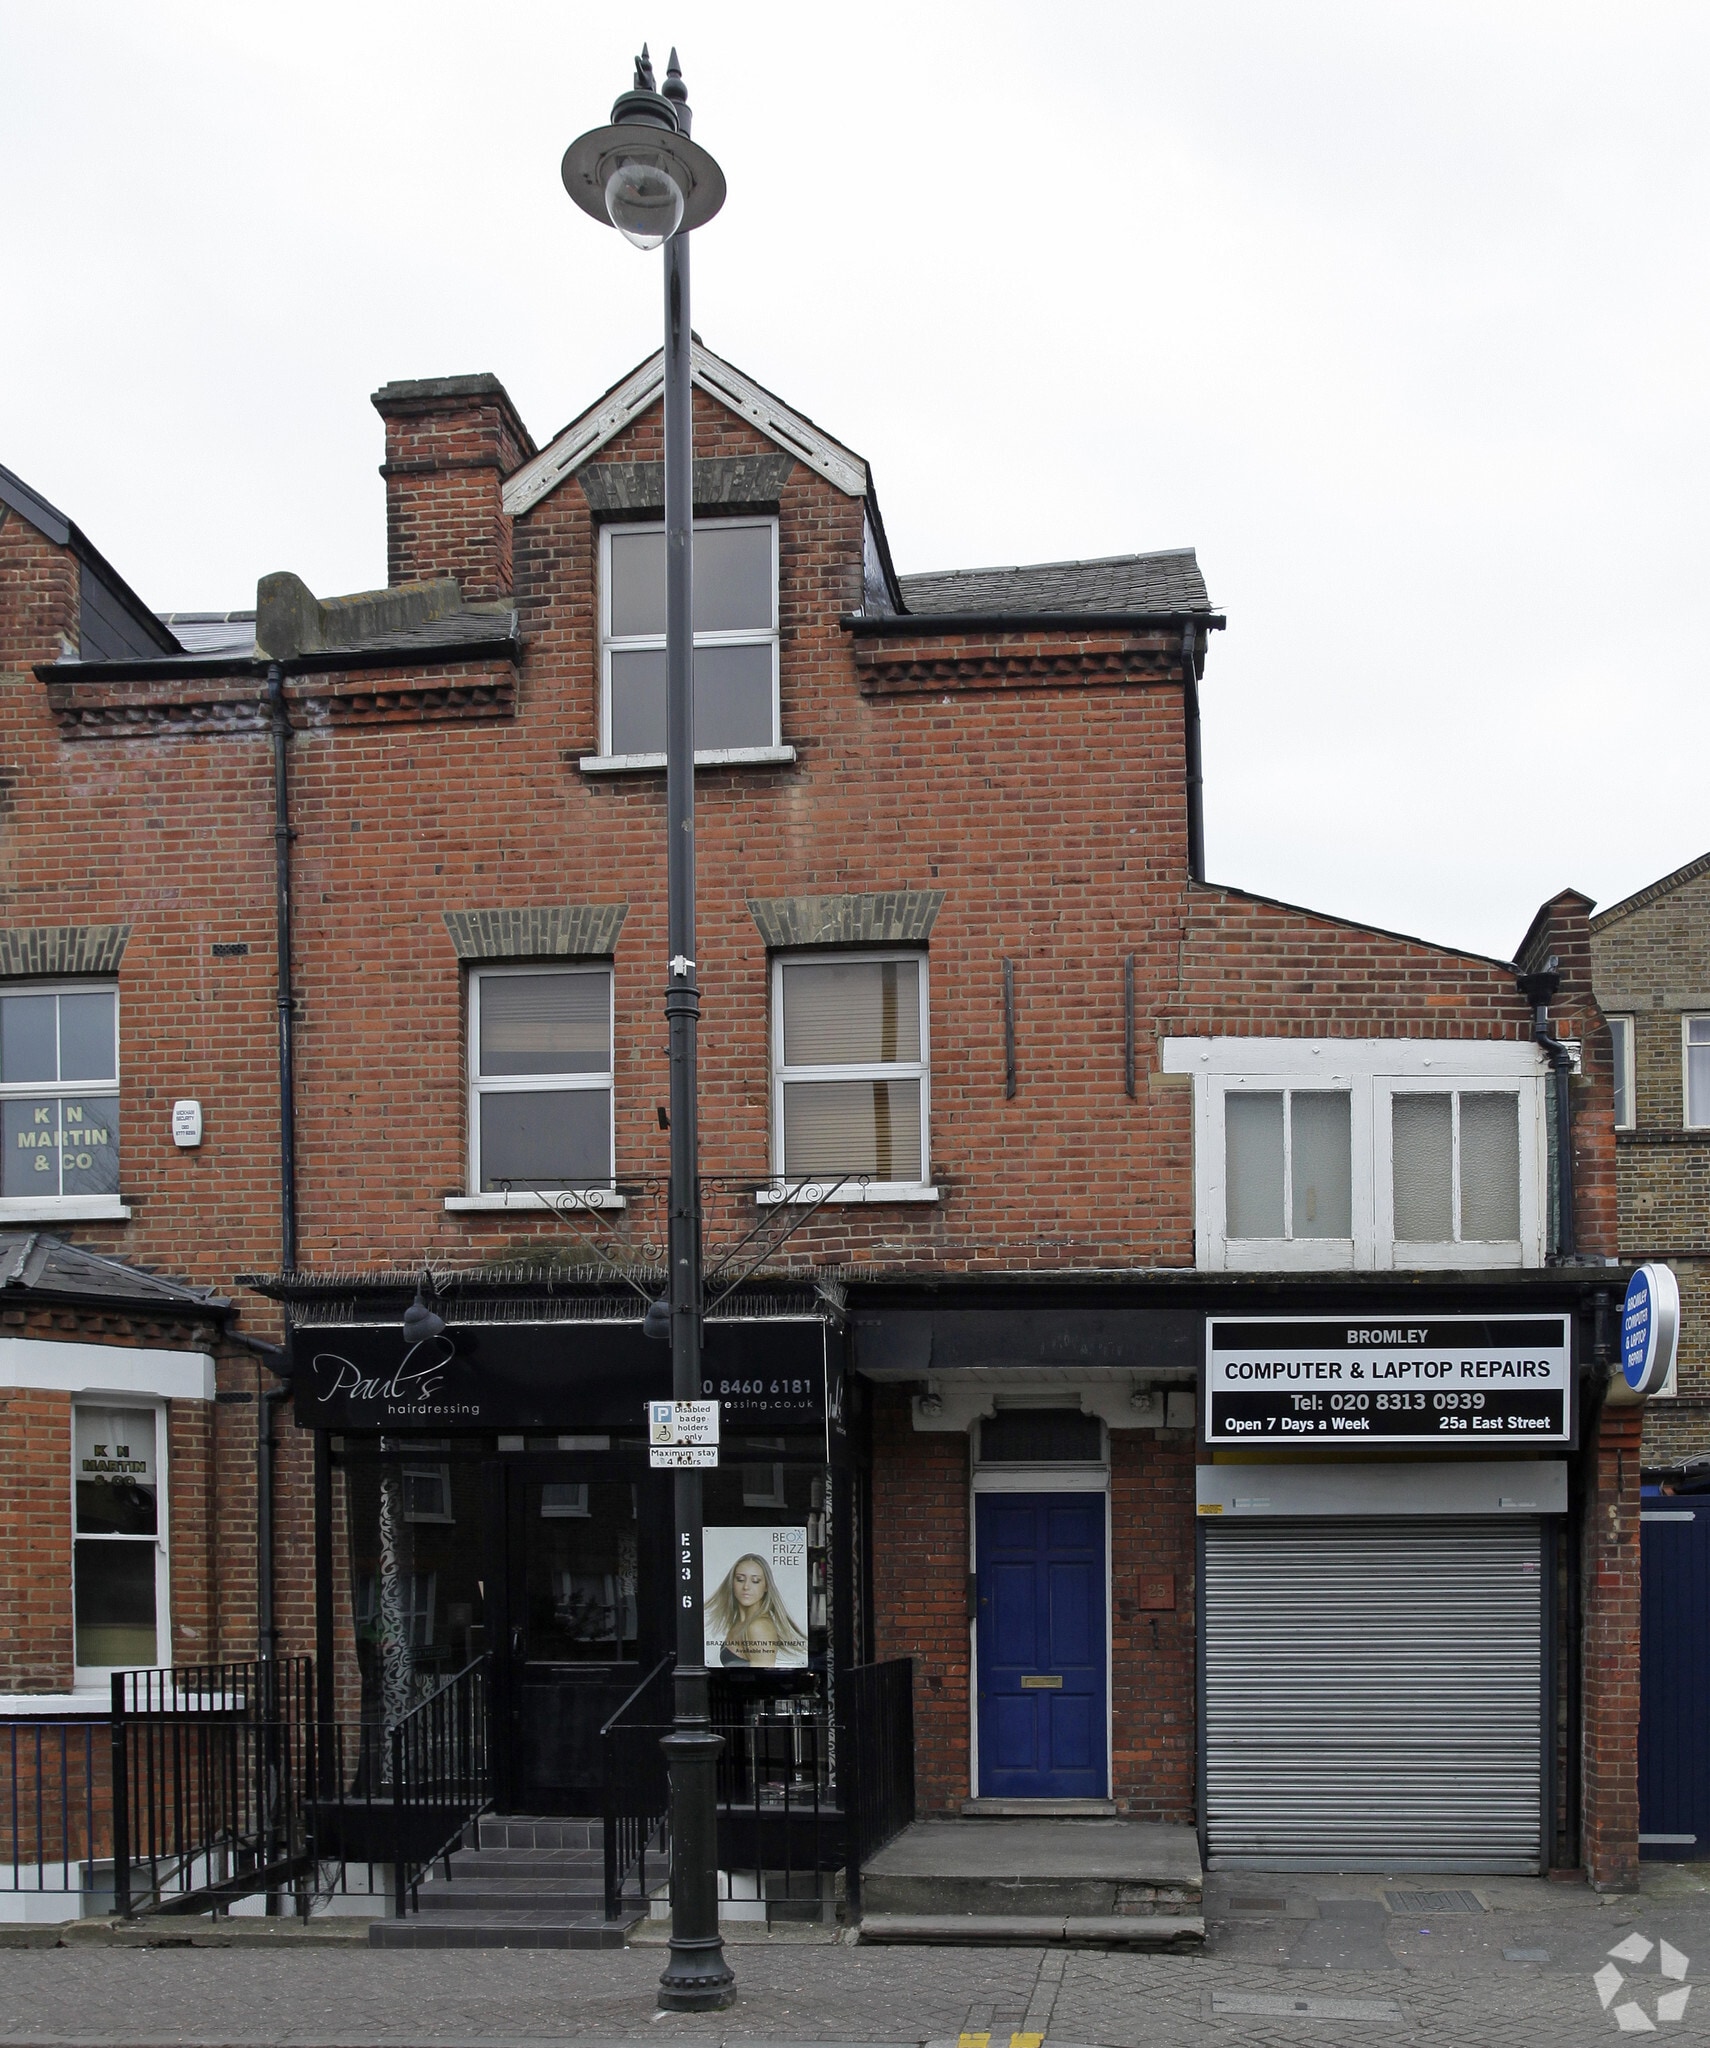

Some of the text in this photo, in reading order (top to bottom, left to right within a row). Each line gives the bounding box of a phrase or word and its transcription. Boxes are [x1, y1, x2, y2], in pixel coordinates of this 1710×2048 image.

[35, 1106, 83, 1124] K N
[18, 1129, 107, 1148] MARTIN
[34, 1153, 93, 1171] & CO
[1627, 1288, 1648, 1312] BROMLEY
[1625, 1308, 1648, 1331] COMPUTER
[1346, 1329, 1428, 1344] BROMLEY
[1625, 1328, 1647, 1350] & LAPTOP
[1628, 1349, 1643, 1368] REPAIR
[313, 1335, 456, 1403] Paul's
[1225, 1360, 1551, 1380] COMPUTER & LAPTOP REPAIRS
[720, 1380, 763, 1394] 8460
[770, 1379, 811, 1394] 6181
[674, 1405, 711, 1413] Disabled
[1291, 1393, 1485, 1411] Tel: 020 8313 0939
[388, 1404, 480, 1415] hairdressing
[657, 1408, 669, 1421] P
[679, 1415, 706, 1423] badge
[1225, 1415, 1551, 1433] Open 7 Days a Week 25a East Street
[677, 1424, 708, 1432] holders
[684, 1433, 703, 1442] only
[95, 1445, 129, 1457] K N
[698, 1450, 716, 1458] stay
[83, 1460, 146, 1473] MARTIN
[677, 1458, 702, 1466] hours
[772, 1530, 804, 1543] BEOX
[772, 1544, 804, 1554] FRIZZ
[772, 1556, 799, 1566] FREE
[1148, 1584, 1166, 1598] 25
